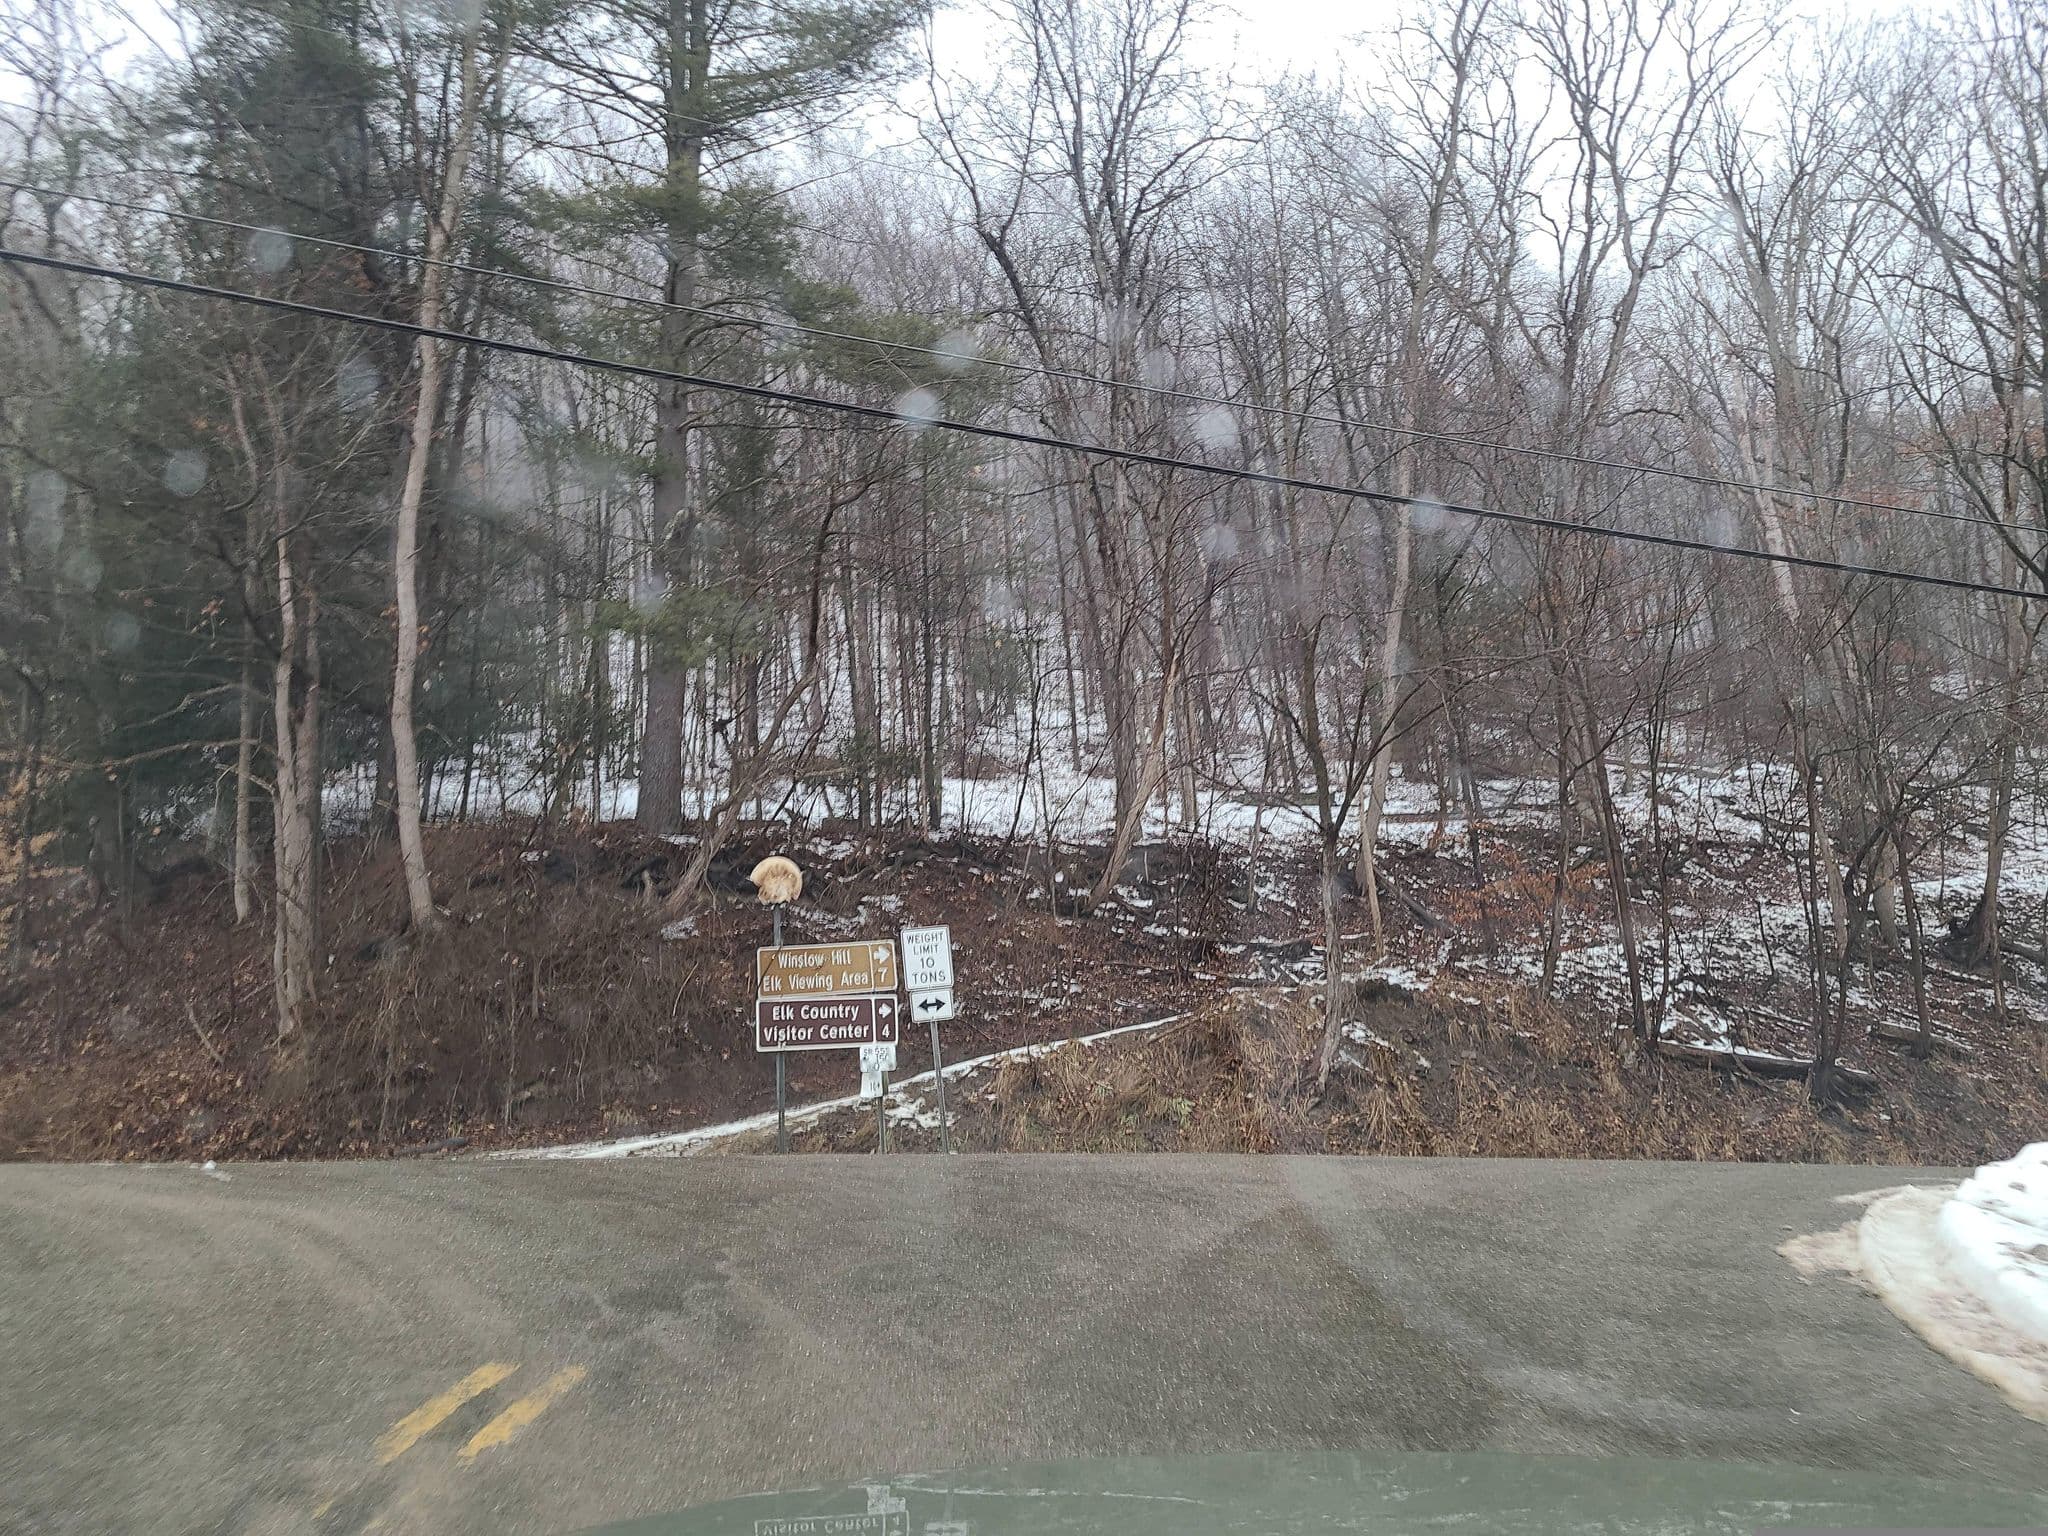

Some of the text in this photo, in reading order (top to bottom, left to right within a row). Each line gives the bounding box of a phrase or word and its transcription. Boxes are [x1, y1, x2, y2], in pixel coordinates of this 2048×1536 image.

[906, 931, 944, 944] WEIGHT
[913, 944, 938, 955] LIMIT
[778, 948, 852, 969] Winslow Hill
[920, 957, 935, 969] 10
[762, 970, 869, 992] Elk Viewing Area
[877, 966, 889, 983] 7
[912, 970, 946, 985] TONS
[772, 1003, 860, 1021] Elk Country
[763, 1023, 870, 1042] Visitor Center
[881, 1023, 890, 1038] 4
